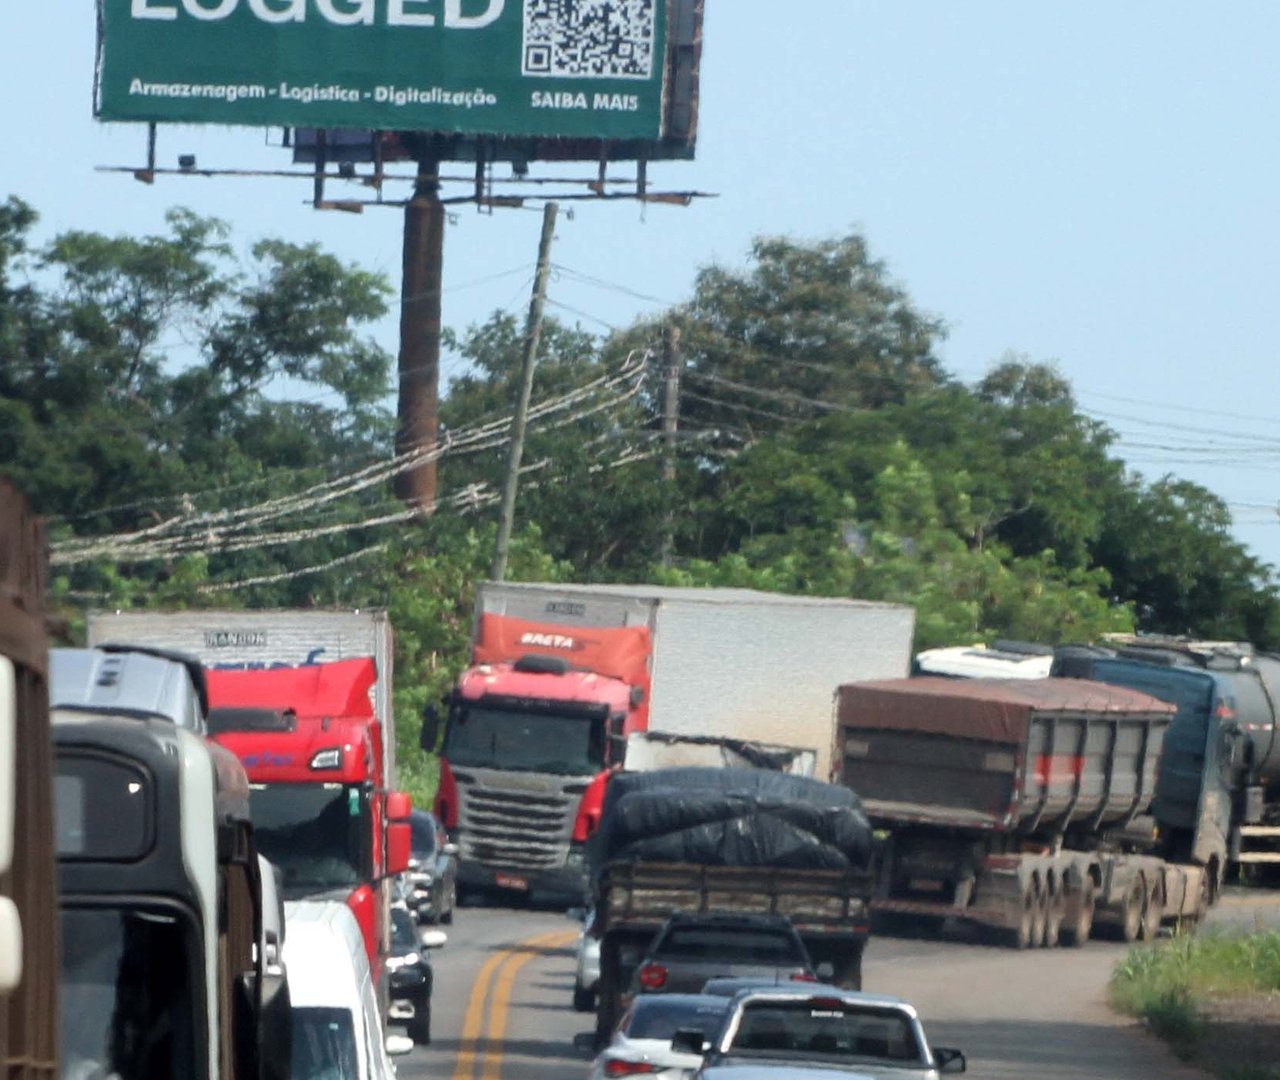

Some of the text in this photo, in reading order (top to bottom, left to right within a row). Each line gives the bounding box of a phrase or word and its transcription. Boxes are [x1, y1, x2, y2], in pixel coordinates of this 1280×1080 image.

[128, 77, 266, 102] Armazenagem
[279, 82, 360, 103] Logística
[374, 86, 498, 109] Digitalização
[531, 91, 639, 112] SAIBA MAIS
